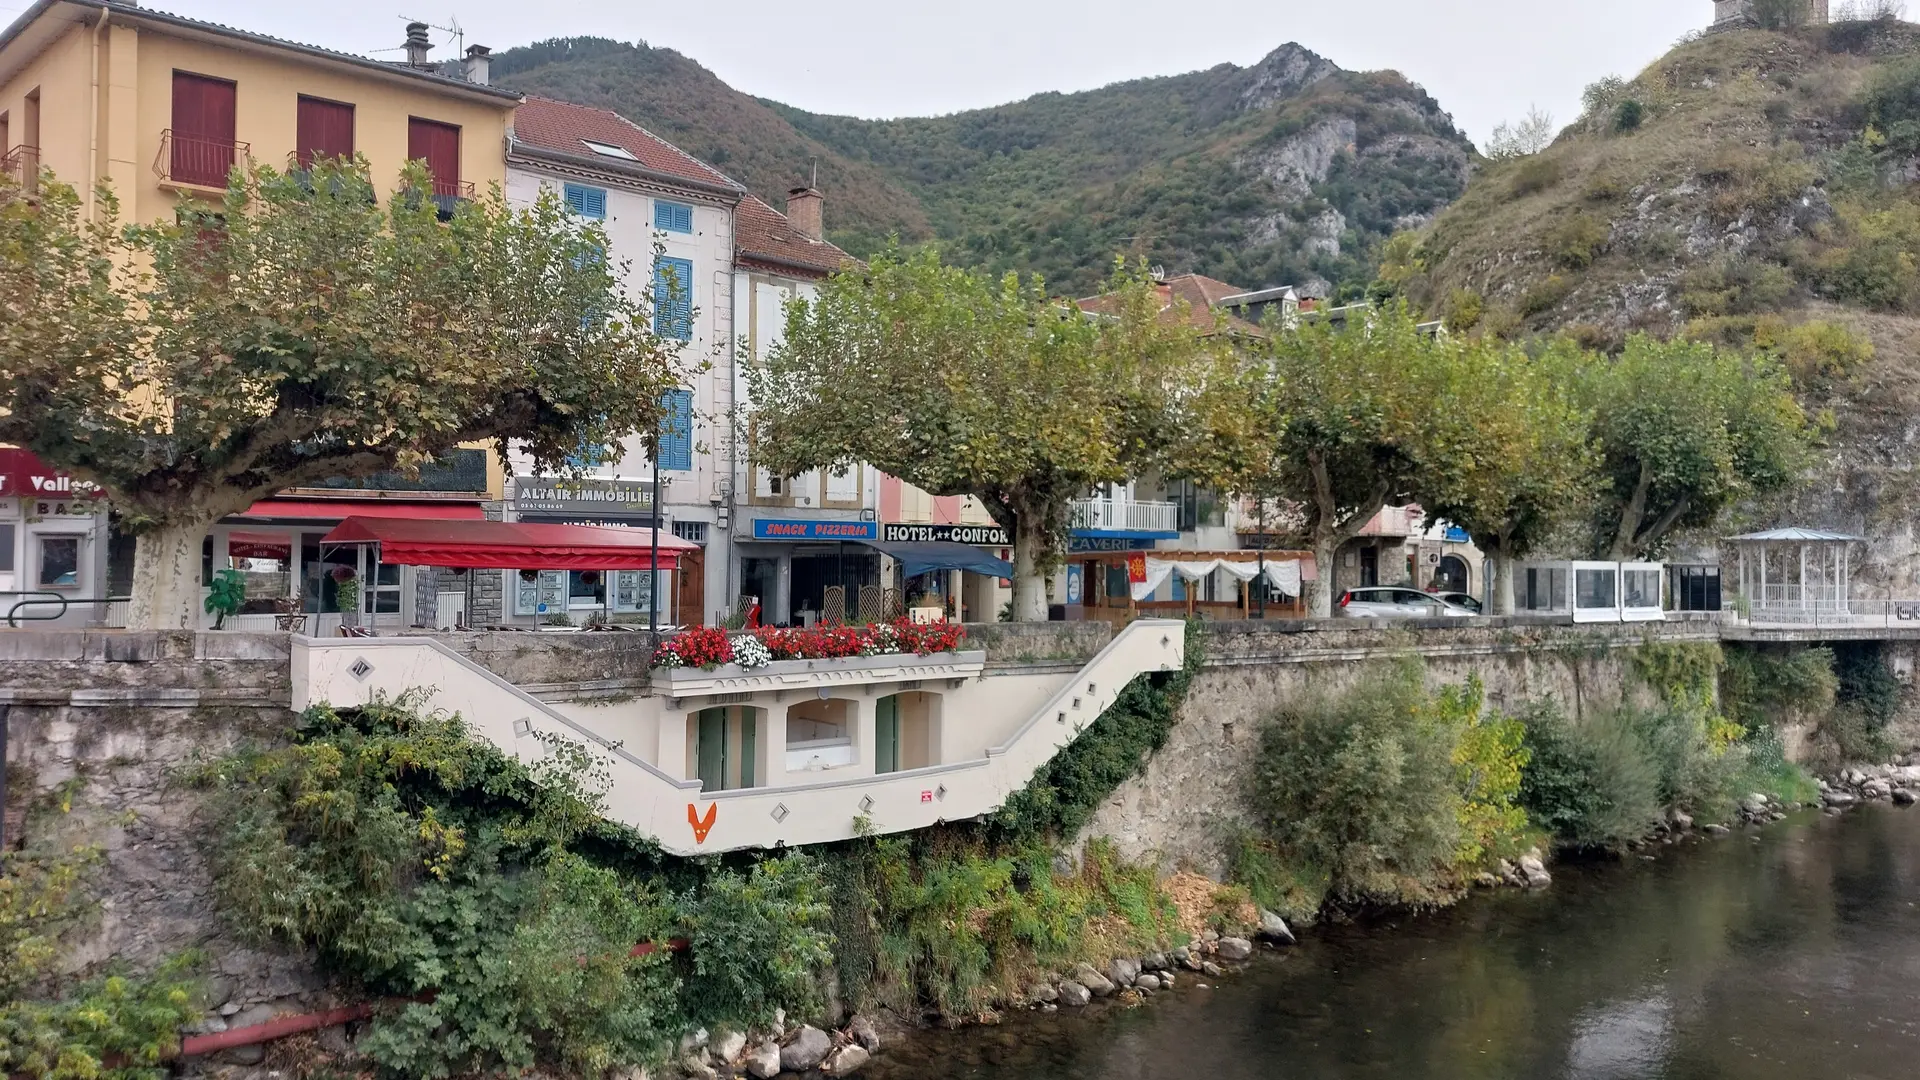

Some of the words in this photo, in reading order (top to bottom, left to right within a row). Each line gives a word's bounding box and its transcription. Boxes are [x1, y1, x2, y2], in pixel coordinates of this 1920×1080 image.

[766, 523, 808, 536] SNACK
[815, 524, 868, 536] PIZZERIA
[887, 526, 936, 542] HOTEL
[950, 527, 1009, 544] CONFOR
[1070, 537, 1135, 550] LAVERIE
